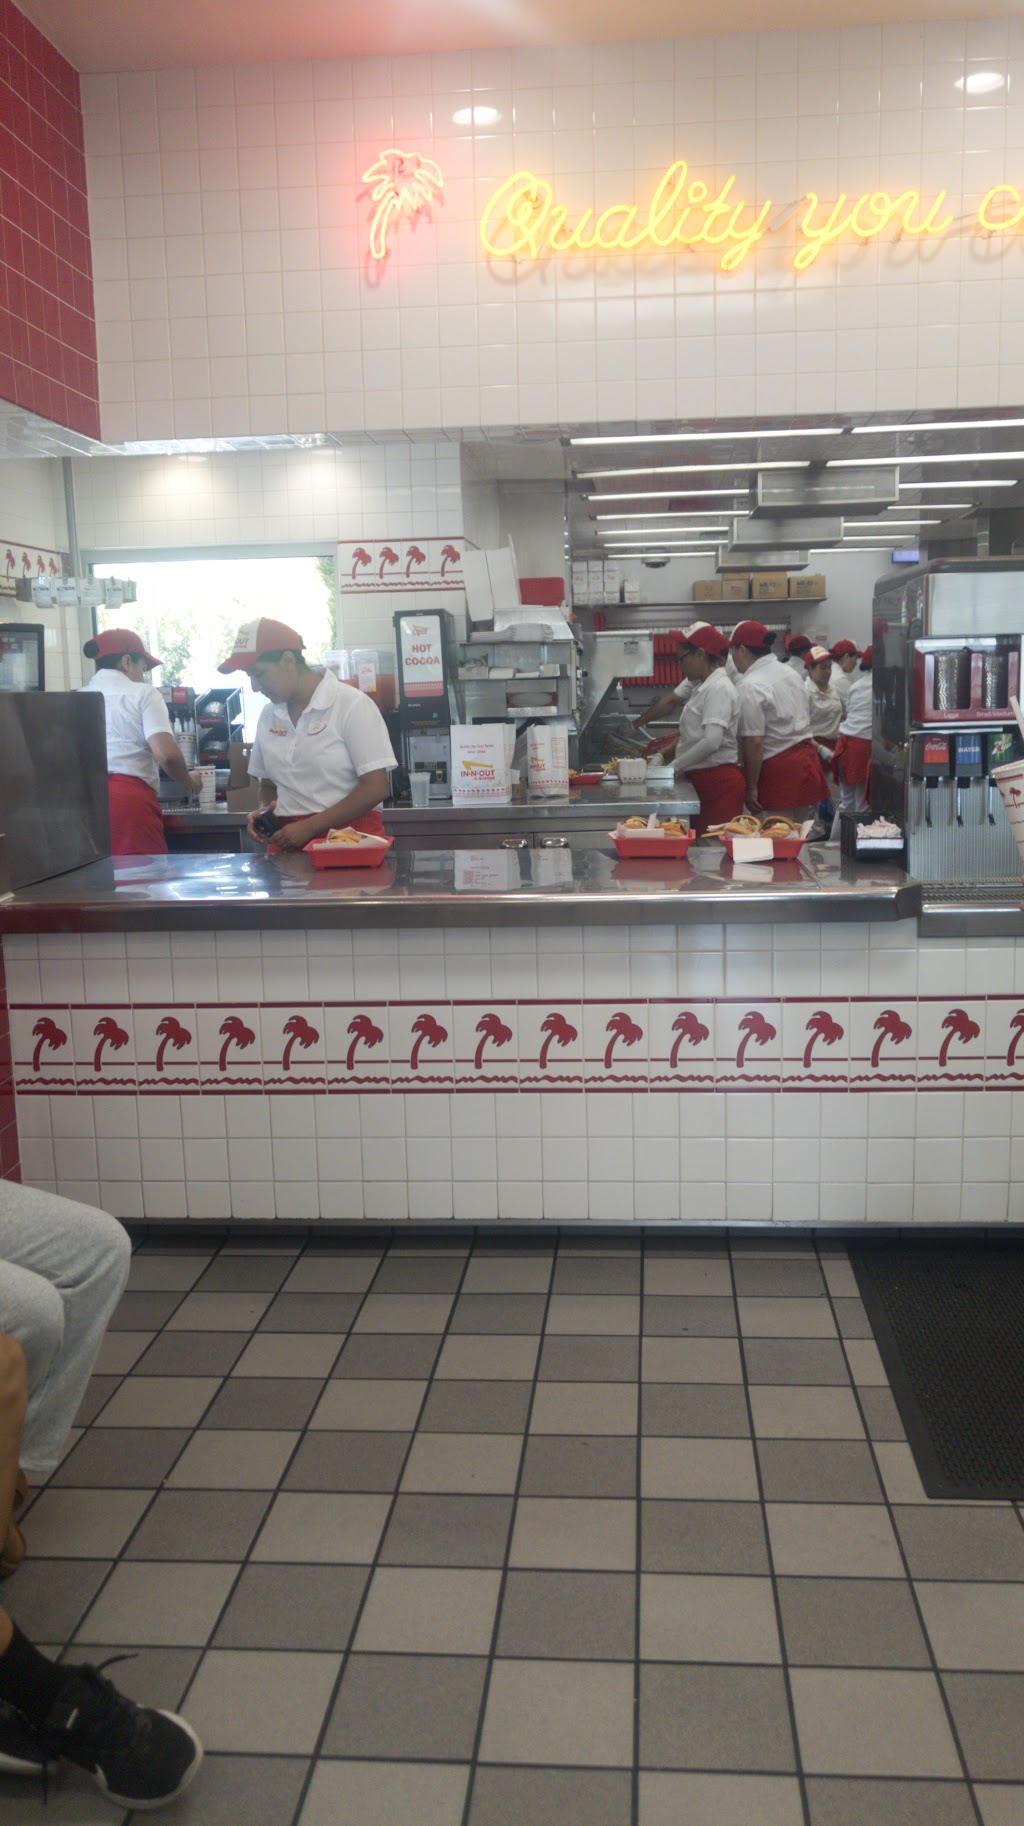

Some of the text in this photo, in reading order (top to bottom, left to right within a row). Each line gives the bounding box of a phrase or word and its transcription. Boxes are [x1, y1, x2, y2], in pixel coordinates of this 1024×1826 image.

[480, 159, 1024, 271] Quality you c
[411, 644, 432, 653] HOT
[405, 656, 440, 666] COCOA
